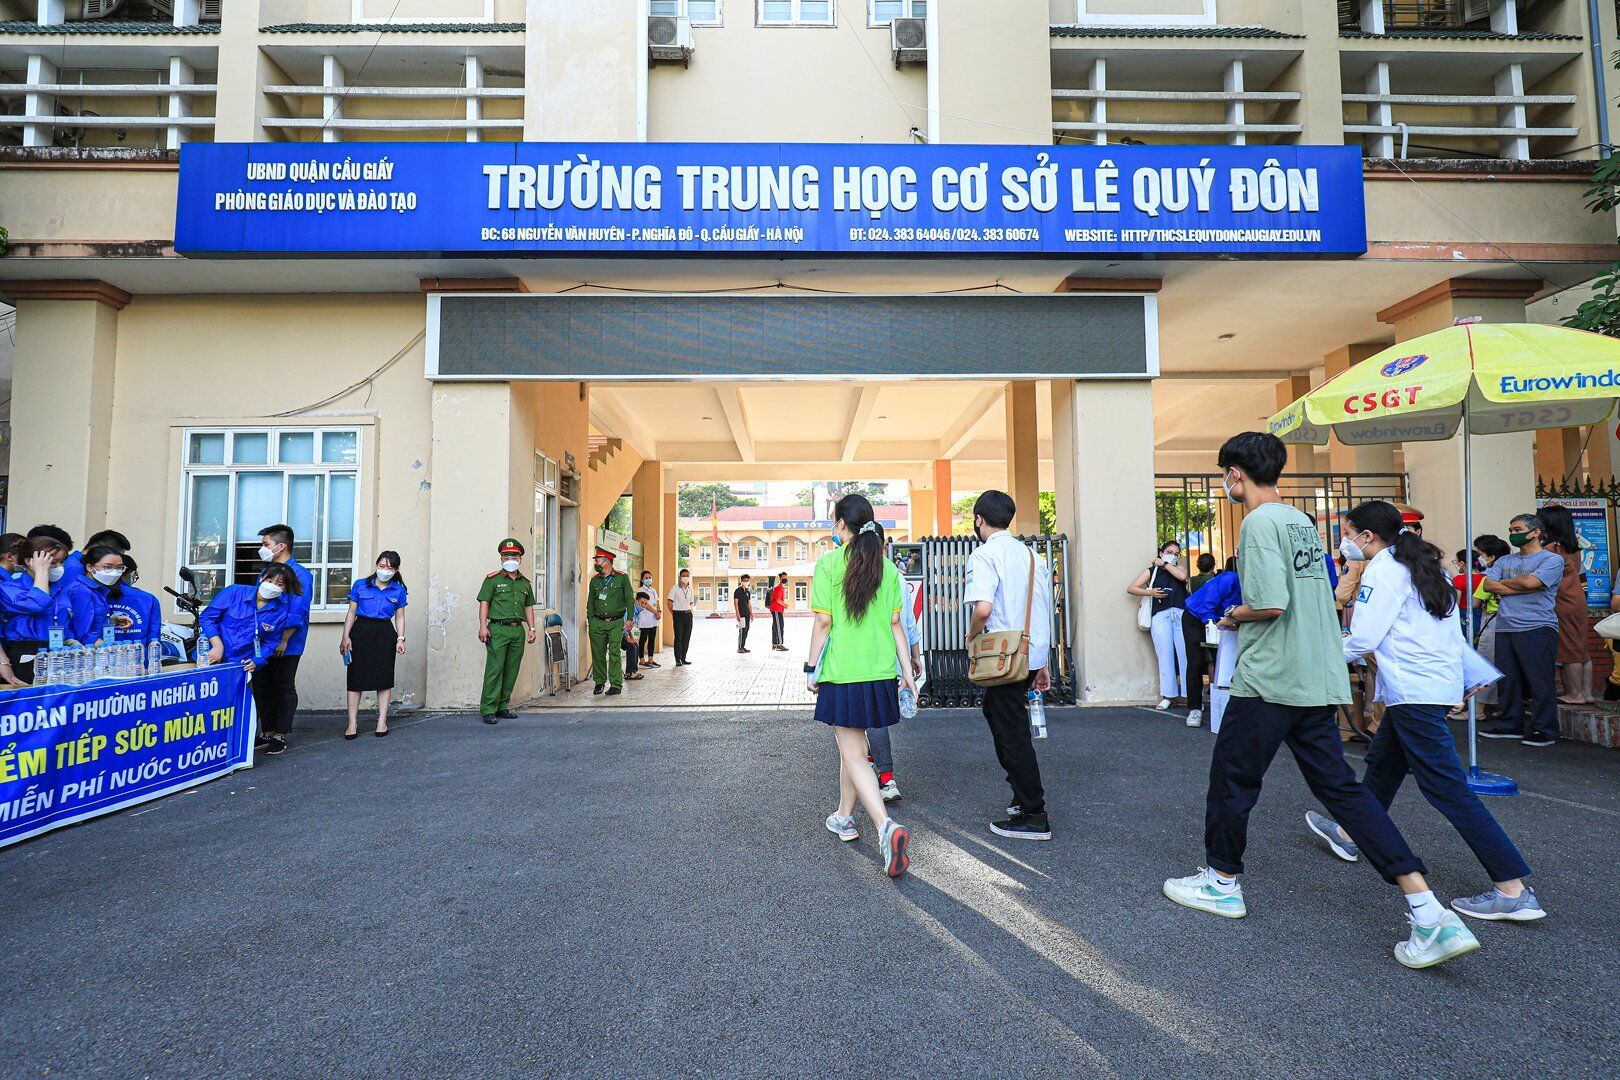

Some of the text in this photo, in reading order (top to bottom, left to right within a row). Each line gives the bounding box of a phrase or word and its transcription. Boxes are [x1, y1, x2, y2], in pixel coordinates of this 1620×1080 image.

[247, 156, 394, 183] UBND QUẬN CẦU GIẤY
[482, 152, 1320, 219] TRƯỜNG TRUNG HỌC CƠ SỞ LÊ QUÝ ĐÔN
[215, 188, 417, 213] PHÒNG GIÁO DỤC VÀ ĐÀO TẠO
[481, 227, 500, 240] ĐC:
[501, 228, 516, 240] 68
[517, 223, 563, 240] NGUYỄN
[564, 225, 587, 240] VĂN
[588, 225, 625, 241] HUYÊN
[678, 226, 694, 241] ĐÔ
[712, 224, 735, 241] CẦU
[735, 224, 760, 241] GIẤY
[766, 226, 782, 241] HÀ
[784, 226, 804, 243] NỘI
[849, 228, 867, 241] ĐT:
[868, 228, 892, 241] 024.
[893, 228, 914, 241] 383
[983, 228, 1003, 241] 383
[1005, 228, 1040, 241] 60674
[1064, 229, 1118, 242] WEBSITE:
[1343, 385, 1423, 414] CSGT
[0, 677, 218, 737] ĐOÀN PHƯỜNG NGHĨA ĐÔ
[55, 727, 107, 769] TIẾP
[114, 720, 158, 755] SỨC
[164, 712, 206, 743] MÙA
[211, 706, 235, 731] THI
[60, 770, 107, 804] PHÍ
[110, 756, 172, 790] NƯỚC
[177, 741, 228, 770] UỐNG
